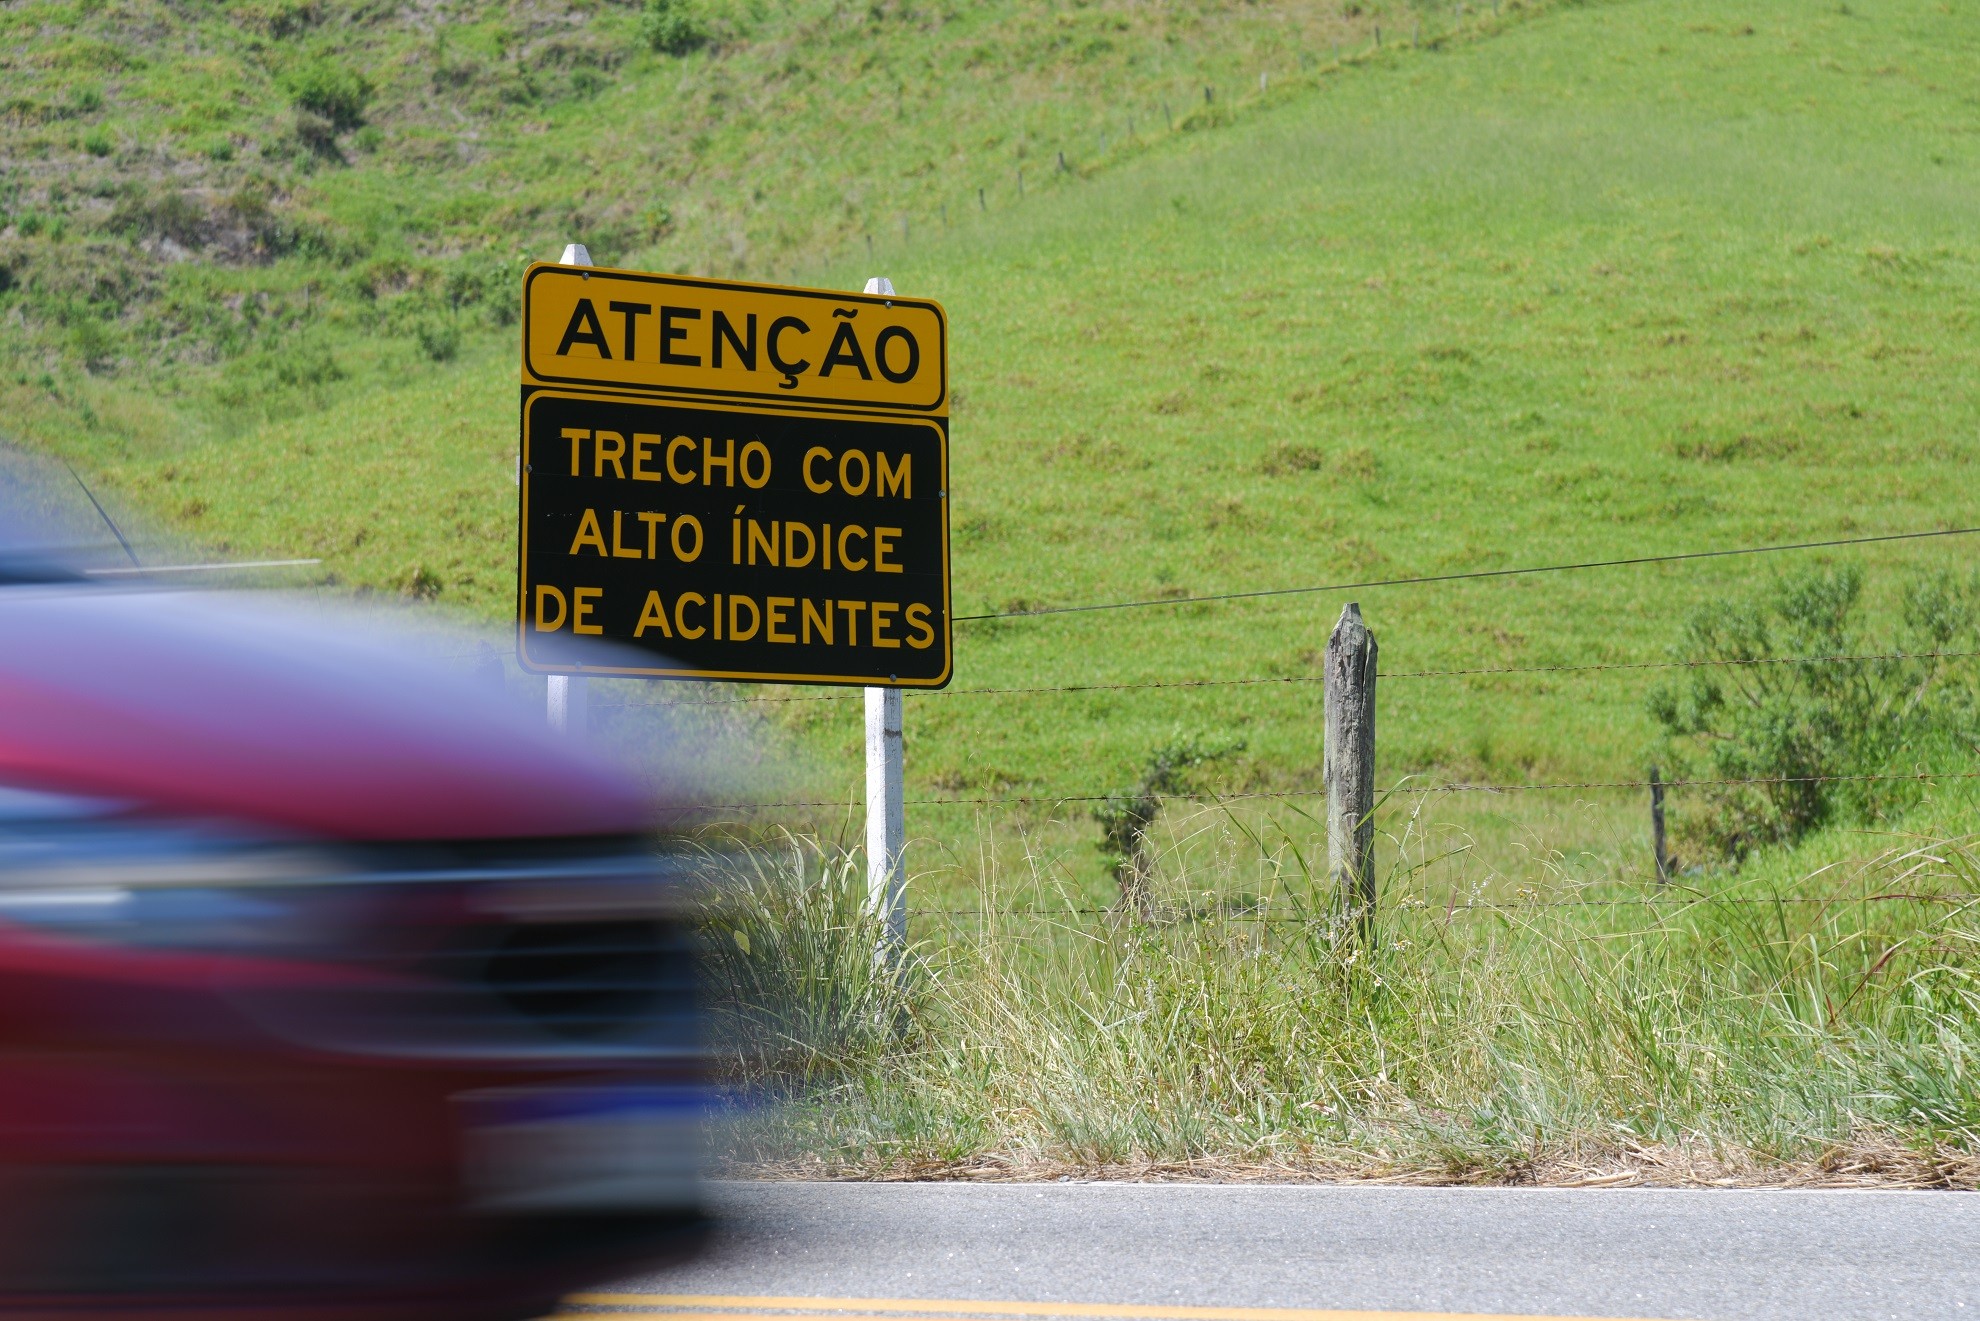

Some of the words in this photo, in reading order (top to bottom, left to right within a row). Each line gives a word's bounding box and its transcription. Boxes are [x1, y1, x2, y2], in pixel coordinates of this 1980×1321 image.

[555, 298, 920, 390] ATENÇÃO
[560, 427, 772, 489] TRECHO
[802, 446, 912, 499] COM
[569, 508, 704, 563] ALTO
[732, 504, 903, 573] ÍNDICE
[534, 584, 604, 635] DE
[633, 590, 935, 649] ACIDENTES
